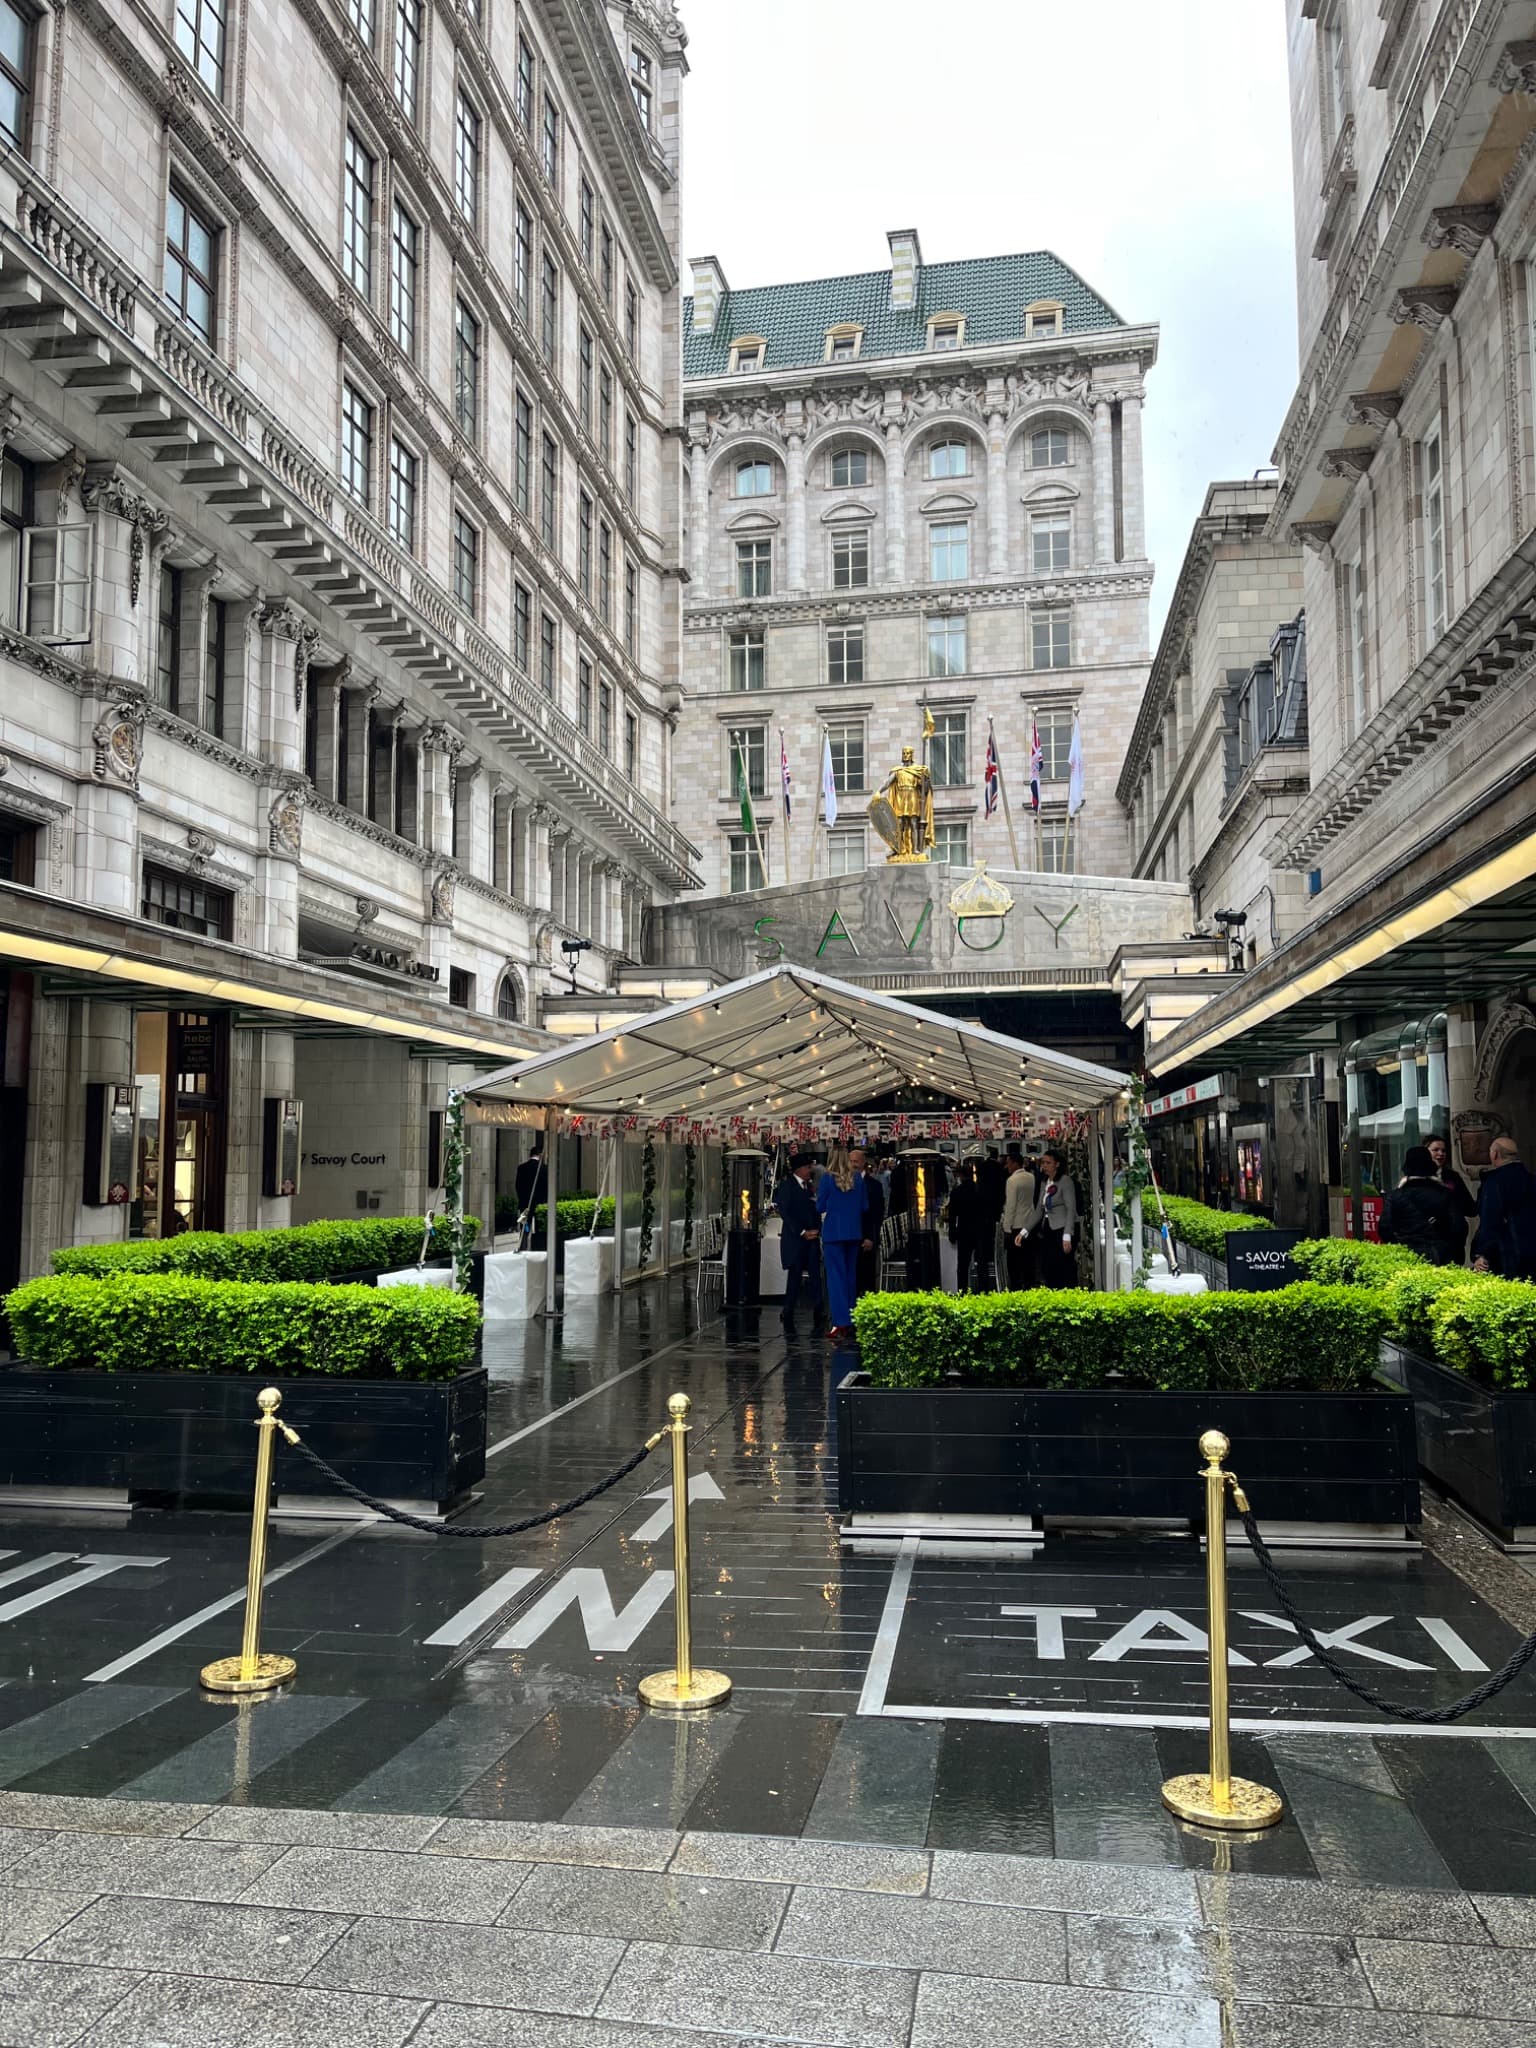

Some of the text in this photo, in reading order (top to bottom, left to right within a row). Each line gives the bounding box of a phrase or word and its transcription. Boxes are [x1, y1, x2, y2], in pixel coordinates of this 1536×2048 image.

[754, 897, 1078, 960] SAVOY
[311, 1153, 347, 1168] Savoy
[351, 1152, 386, 1165] Court
[1245, 1251, 1288, 1263] SAVOY
[422, 1567, 676, 1652] IN
[1001, 1606, 1491, 1672] TAXI
